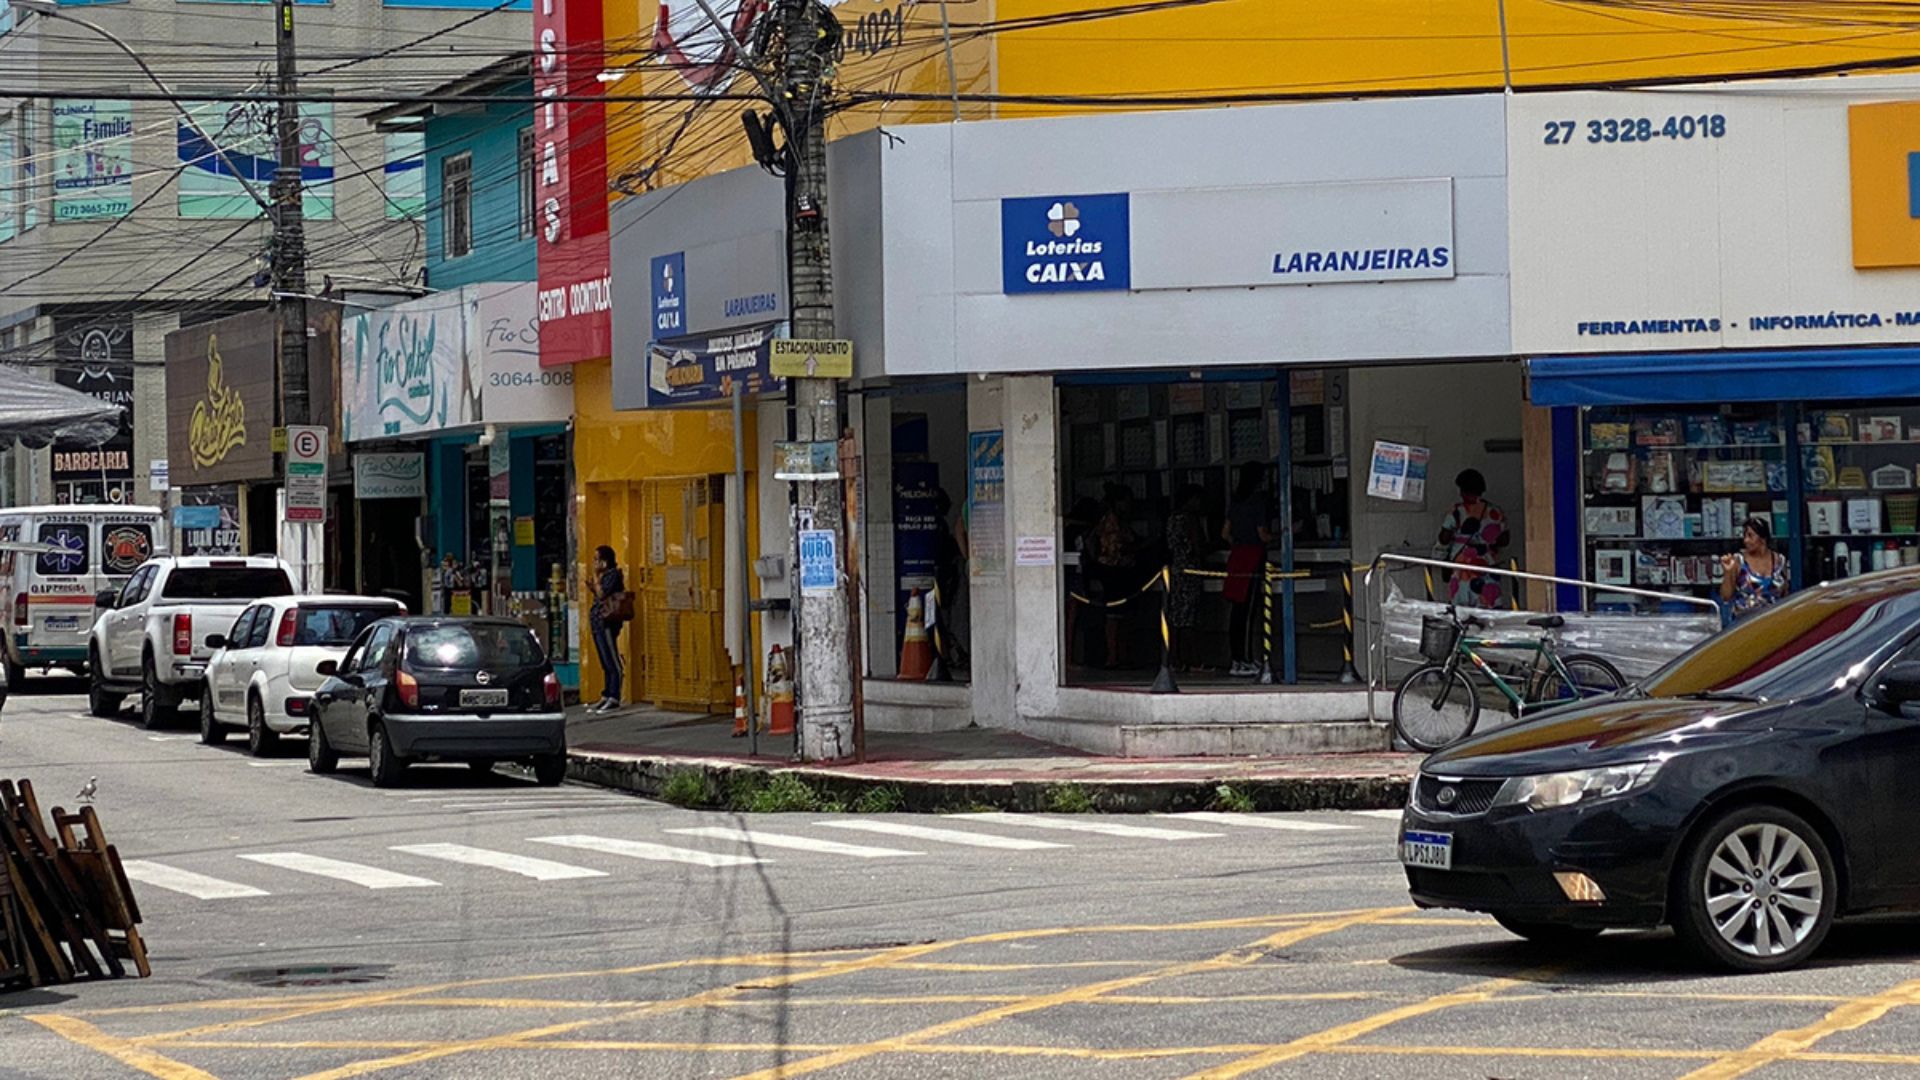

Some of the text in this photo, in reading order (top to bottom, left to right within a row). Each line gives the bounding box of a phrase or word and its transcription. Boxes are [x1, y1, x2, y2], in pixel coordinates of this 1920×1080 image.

[1543, 114, 1726, 145] 27 3328-4018
[1026, 237, 1103, 256] Loterias
[1026, 261, 1105, 283] CAIXA
[1273, 247, 1449, 273] LARANJEIRAS
[539, 286, 567, 322] CENTRO
[724, 293, 777, 317] LARANJEIRAS
[486, 317, 517, 348] Fio
[1577, 318, 1721, 336] FERRAMENTAS
[1750, 311, 1882, 331] INFORMÁTICA
[775, 341, 849, 355] ESTACIONAMENTO
[1331, 375, 1342, 400] 5
[302, 437, 312, 452] E
[54, 450, 129, 471] BARBEARIA
[802, 540, 833, 559] OURO
